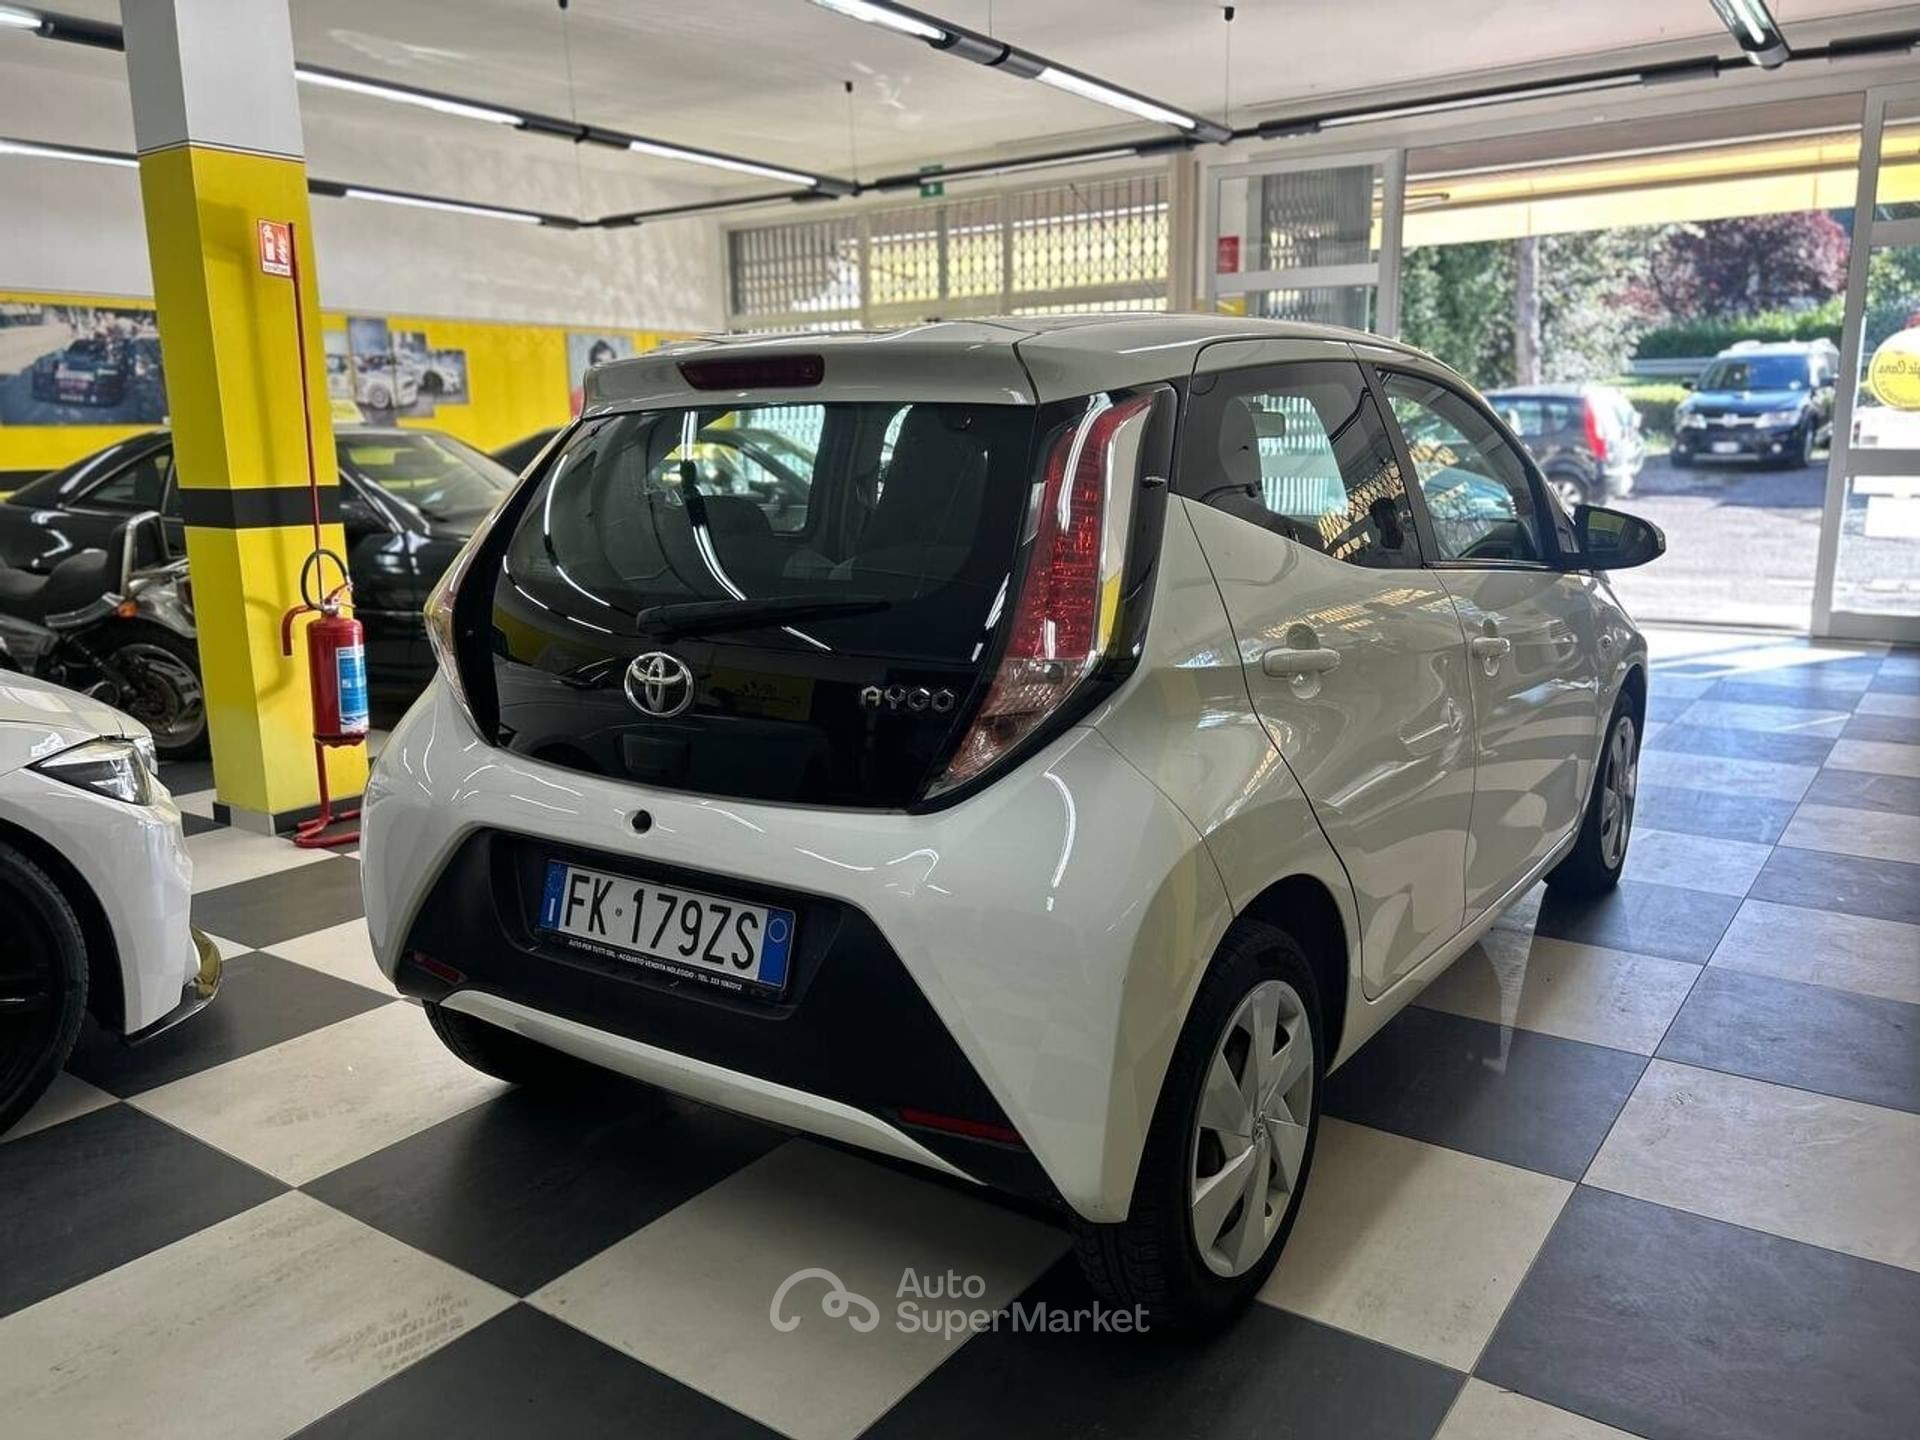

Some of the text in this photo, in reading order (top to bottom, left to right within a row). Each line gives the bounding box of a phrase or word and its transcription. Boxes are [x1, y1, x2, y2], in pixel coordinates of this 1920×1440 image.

[861, 685, 955, 712] AYGO
[568, 940, 581, 948] AUTO
[619, 953, 645, 965] ACQUISTO
[645, 960, 666, 971] VENDITA
[666, 966, 694, 978] NOLEGGIO
